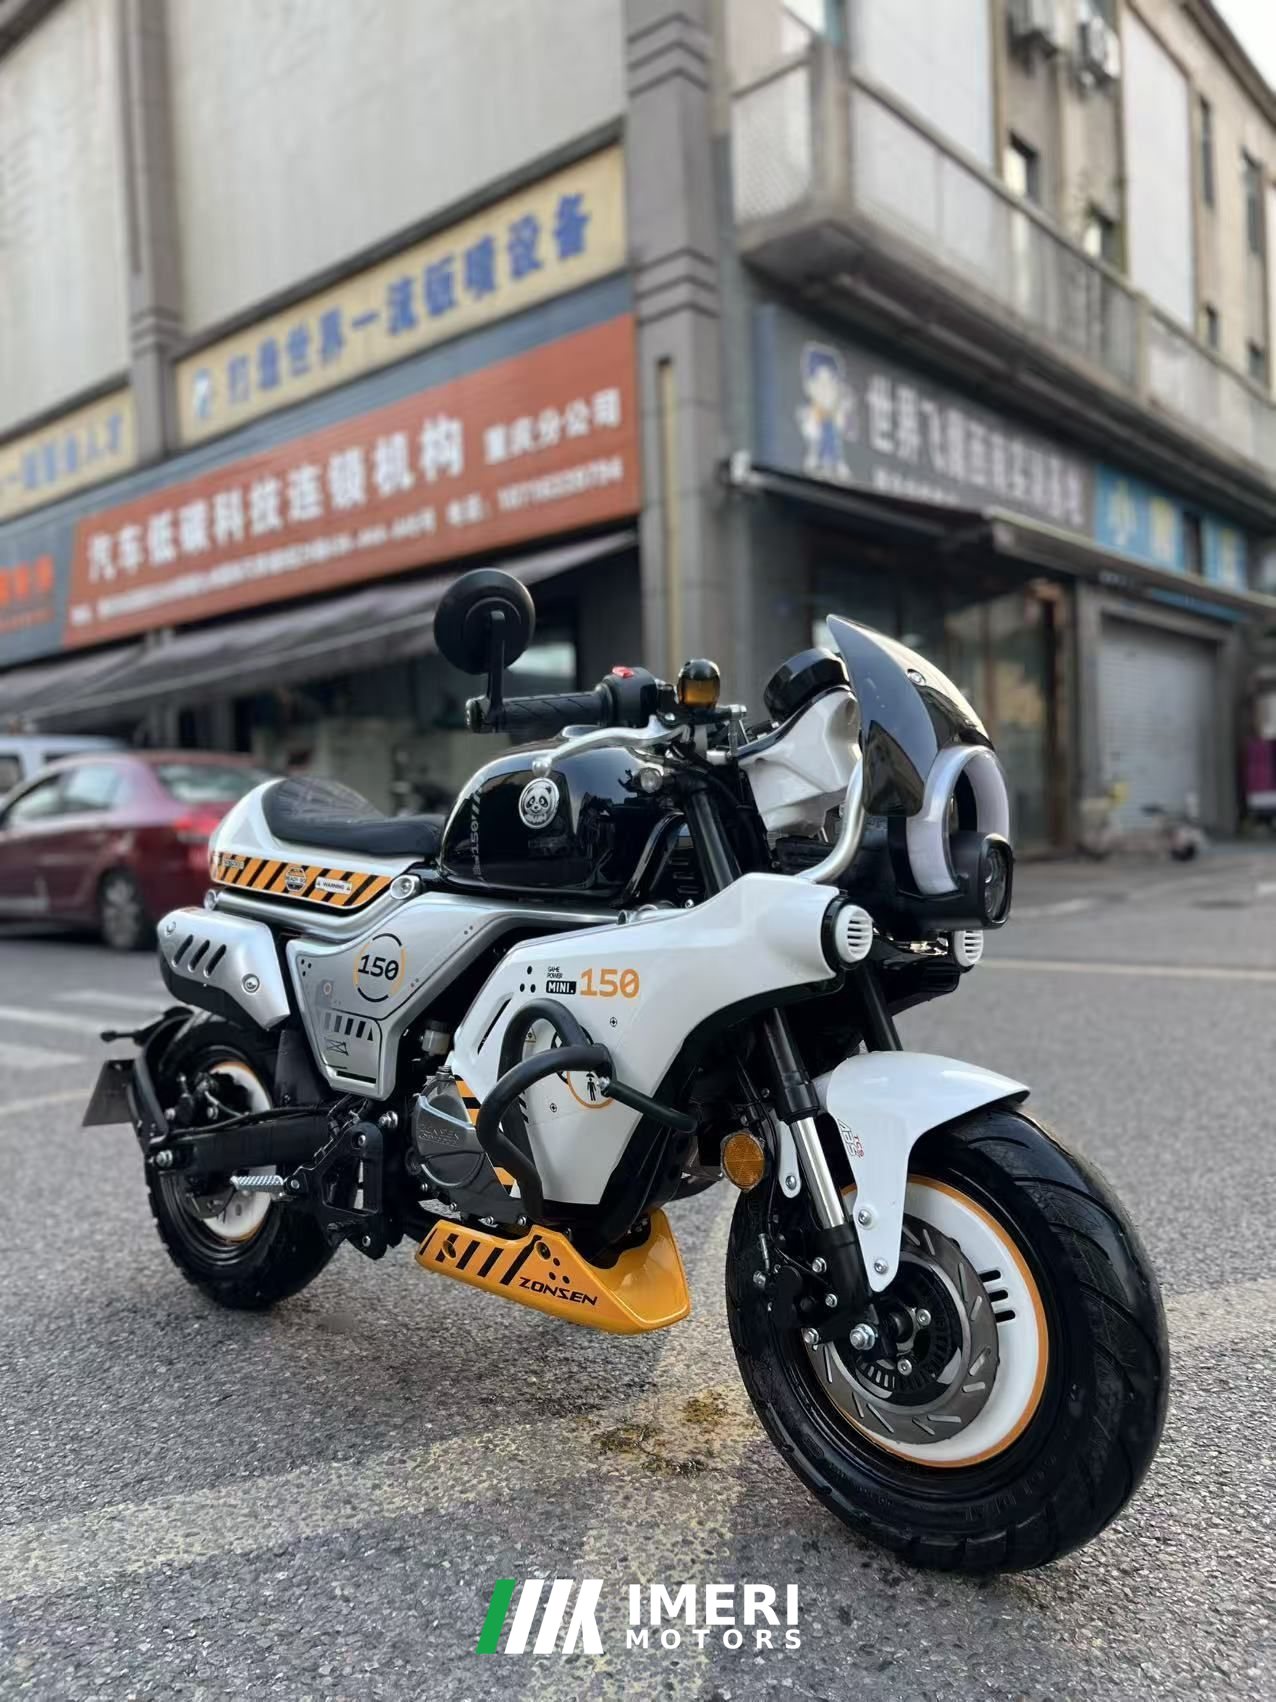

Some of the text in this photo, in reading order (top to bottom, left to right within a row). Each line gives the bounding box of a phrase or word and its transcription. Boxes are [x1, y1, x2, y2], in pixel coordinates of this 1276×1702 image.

[323, 881, 345, 890] WARNING
[357, 954, 399, 980] 150
[548, 968, 640, 998] MINI. 150
[837, 1119, 857, 1157] ABS
[519, 1276, 598, 1306] ZONSEN
